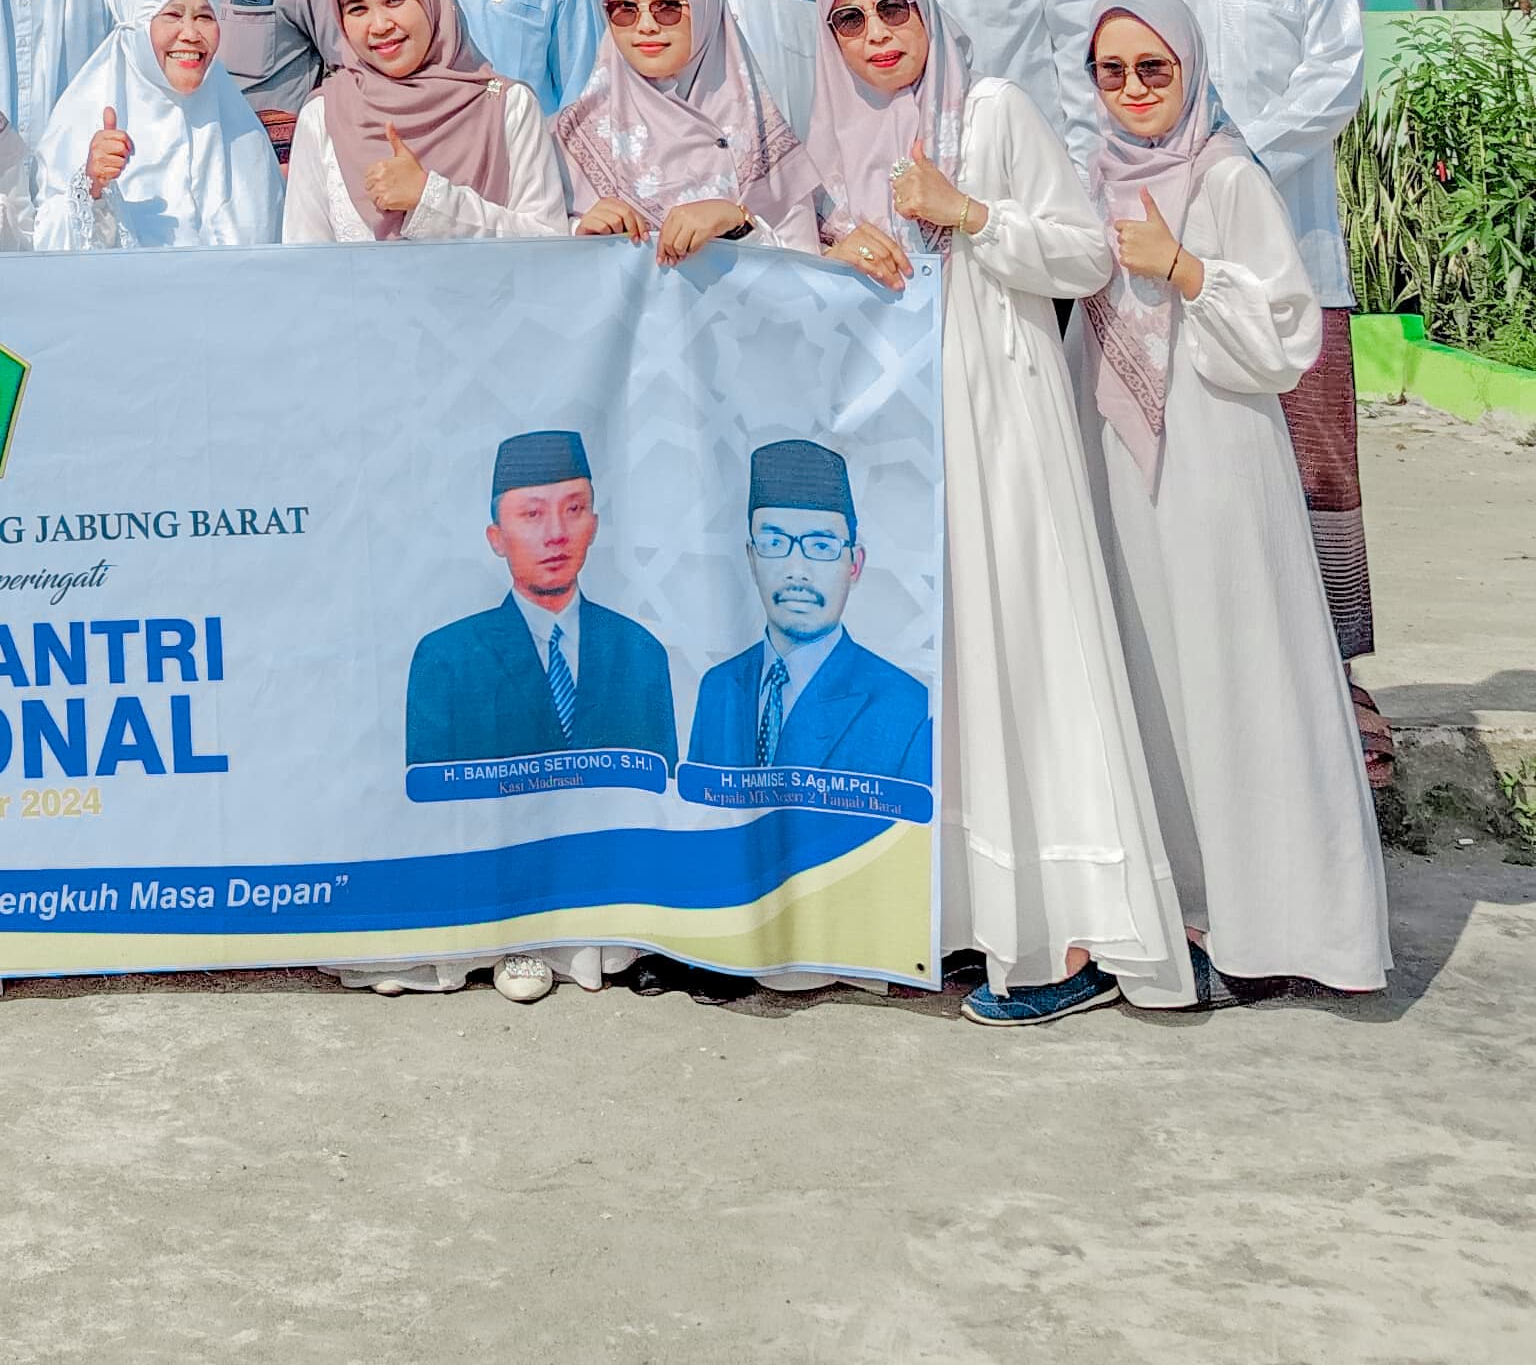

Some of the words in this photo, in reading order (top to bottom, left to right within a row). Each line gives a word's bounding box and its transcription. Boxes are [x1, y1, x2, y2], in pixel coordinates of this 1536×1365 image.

[33, 511, 181, 543] JABUNG
[188, 506, 310, 537] BARAT
[444, 769, 459, 782] H.
[464, 760, 540, 781] BAMBANG
[721, 773, 737, 788] H.
[741, 772, 788, 788] HAMISE,
[498, 778, 525, 795] Kasi
[807, 791, 816, 803] 2
[21, 787, 103, 819] 2024
[129, 880, 215, 911] Masa
